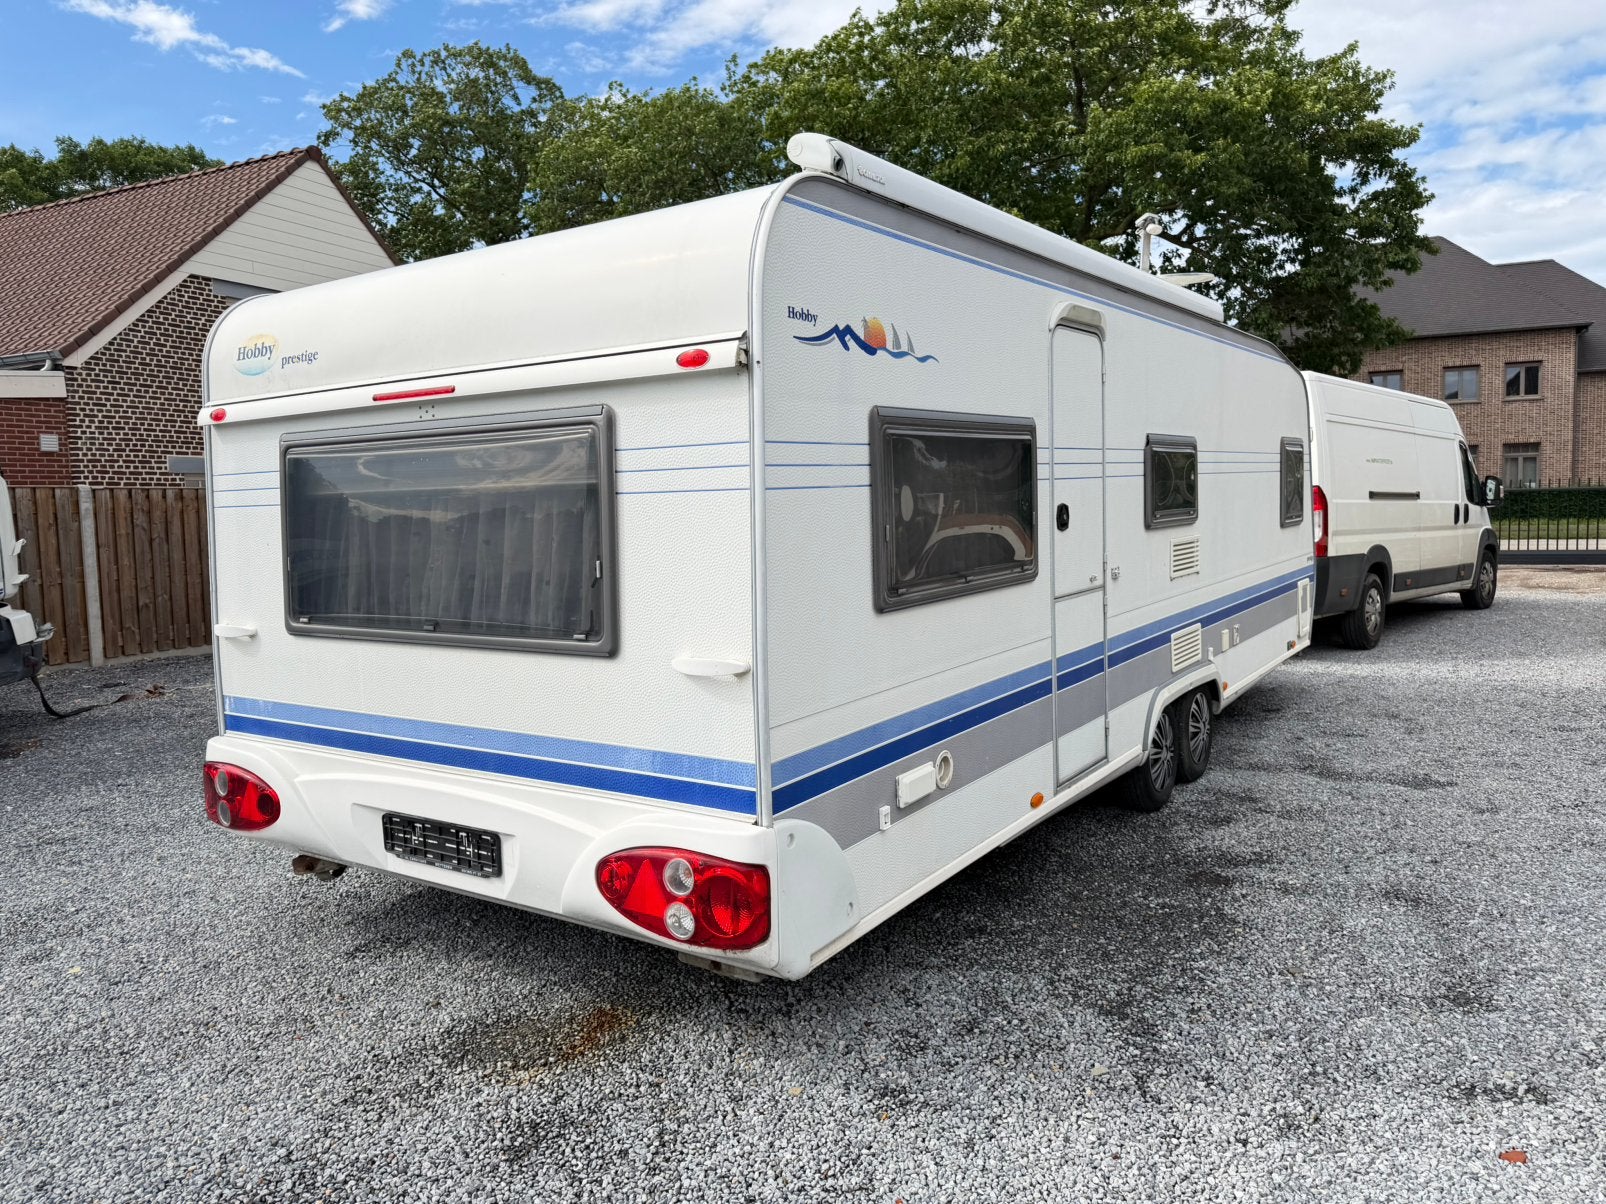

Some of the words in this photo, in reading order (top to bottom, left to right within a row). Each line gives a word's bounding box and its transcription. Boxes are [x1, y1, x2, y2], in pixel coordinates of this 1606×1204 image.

[787, 305, 818, 327] Hobby
[236, 342, 276, 361] Hobby
[281, 350, 319, 369] prestige
